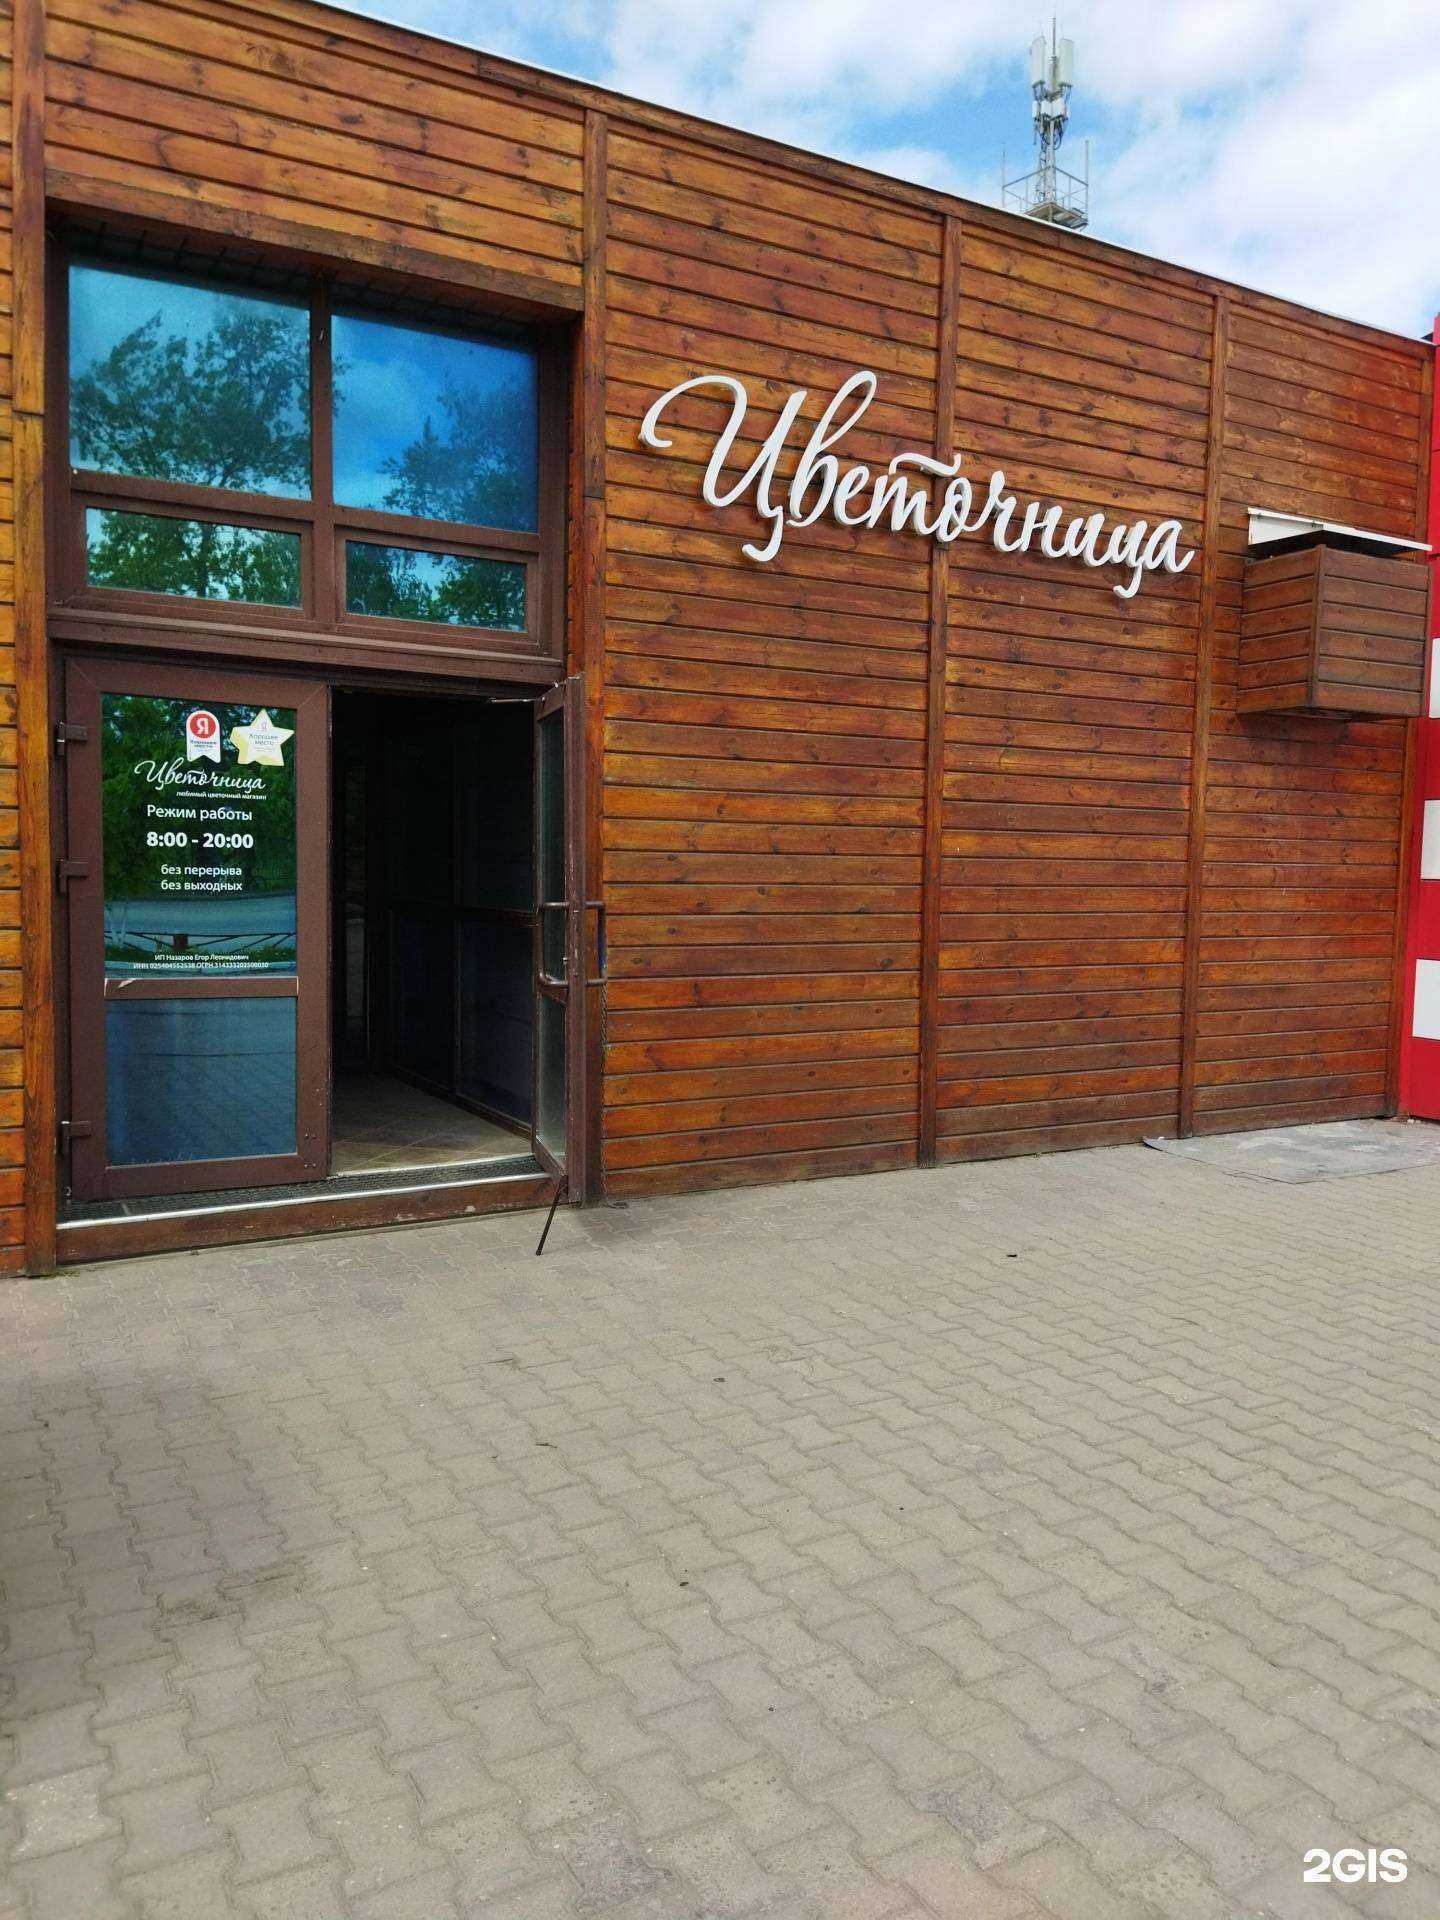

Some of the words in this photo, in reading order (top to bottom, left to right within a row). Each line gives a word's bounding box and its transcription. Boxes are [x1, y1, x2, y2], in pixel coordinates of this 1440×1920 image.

[638, 369, 1195, 599] Цветочница
[196, 717, 209, 735] Я
[134, 757, 266, 793] Цветочница
[147, 804, 197, 819] Режим
[200, 806, 253, 821] работы
[146, 831, 188, 847] 8:00
[202, 832, 254, 849] 20:00
[160, 864, 182, 875] без
[184, 866, 242, 877] перерыва
[160, 879, 182, 890] без
[184, 881, 243, 892] выходных
[167, 954, 193, 962] Назаров
[195, 954, 209, 962] Егор
[210, 954, 249, 962] Леонидович
